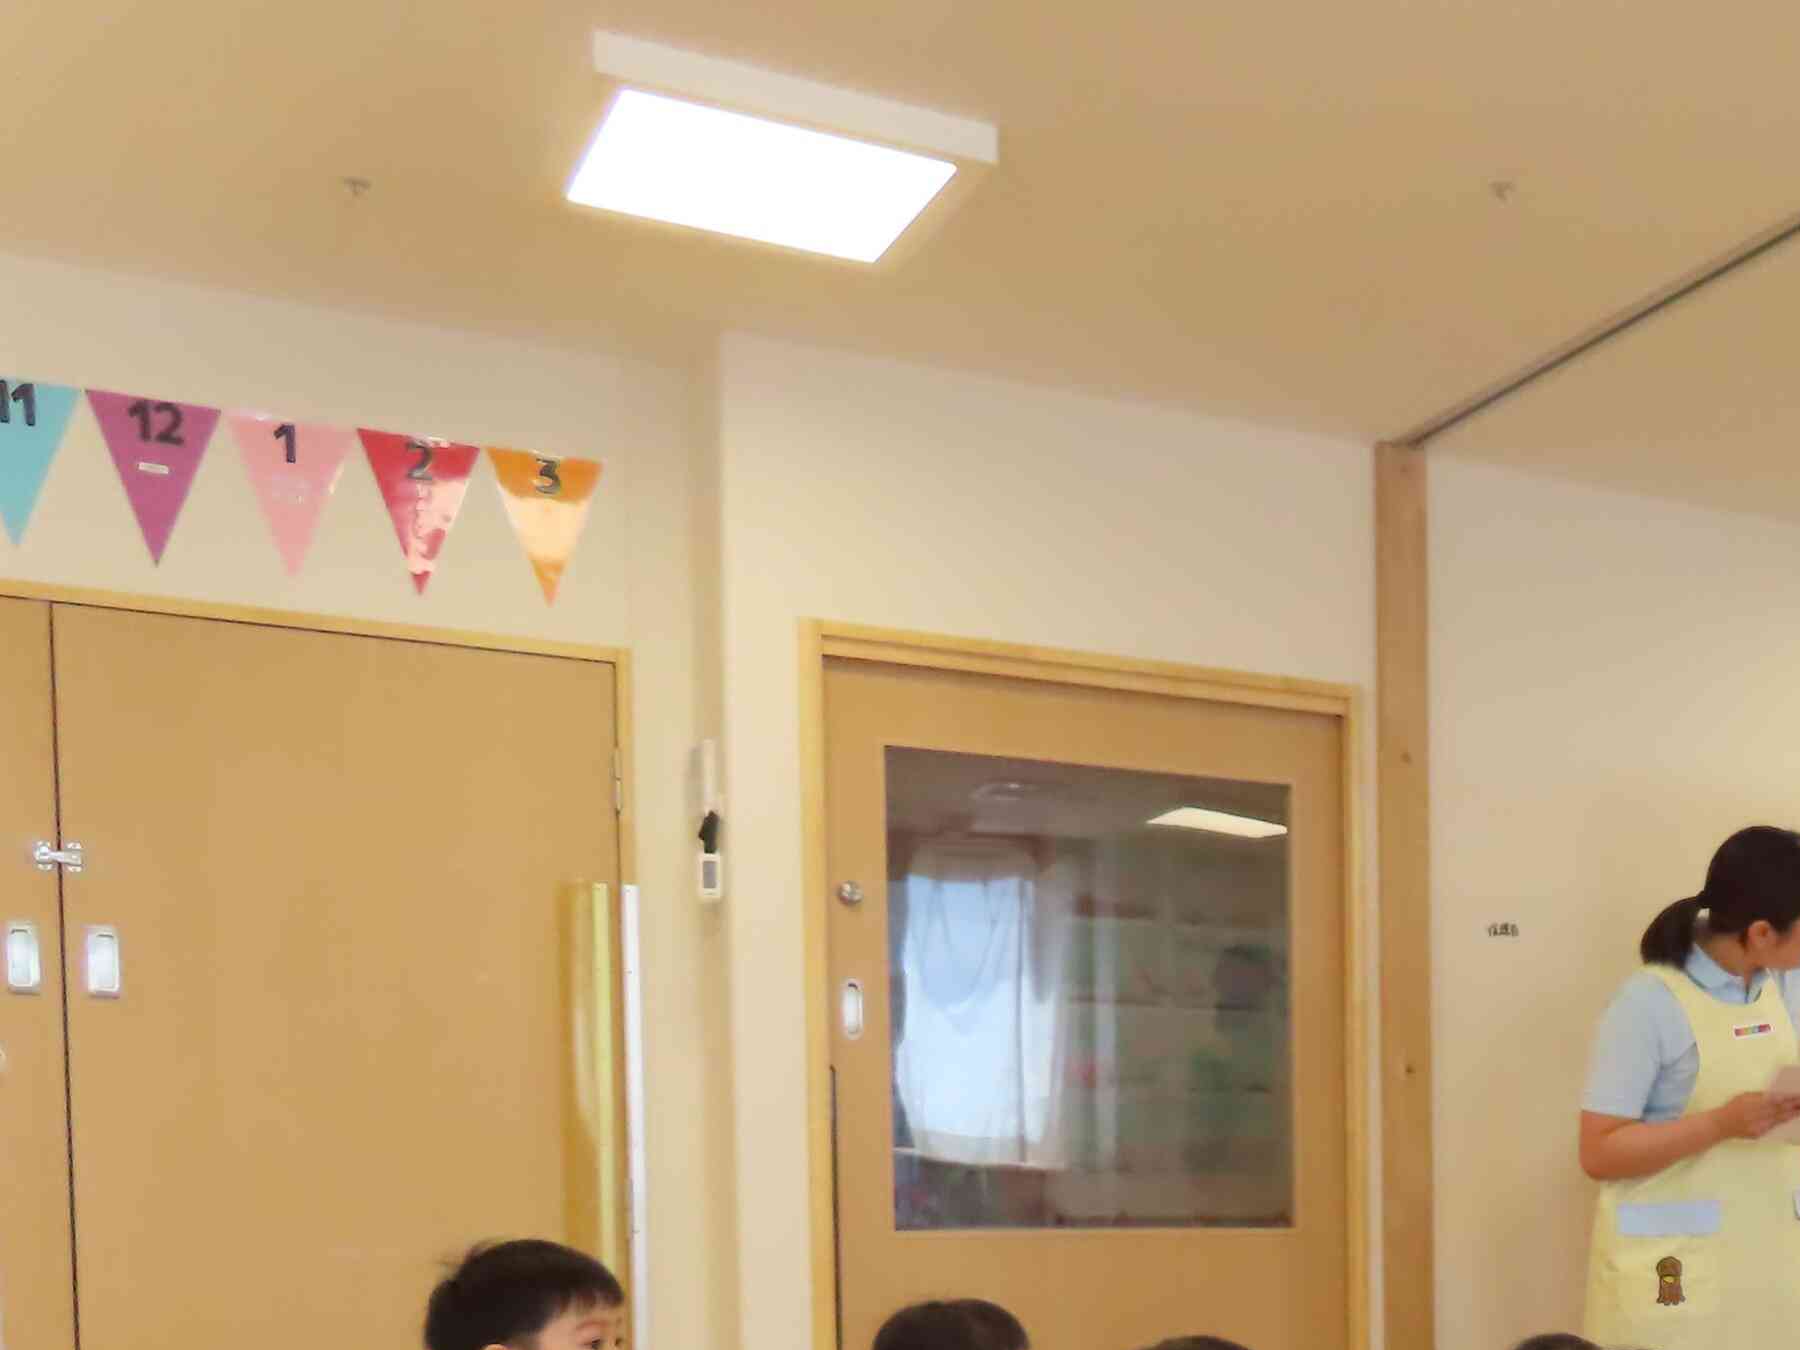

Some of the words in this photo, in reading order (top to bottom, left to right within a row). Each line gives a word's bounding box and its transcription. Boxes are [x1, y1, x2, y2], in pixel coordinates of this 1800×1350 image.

[128, 399, 185, 446] 12
[273, 424, 297, 463] 1
[407, 439, 433, 481] 2
[534, 457, 562, 494] 3
